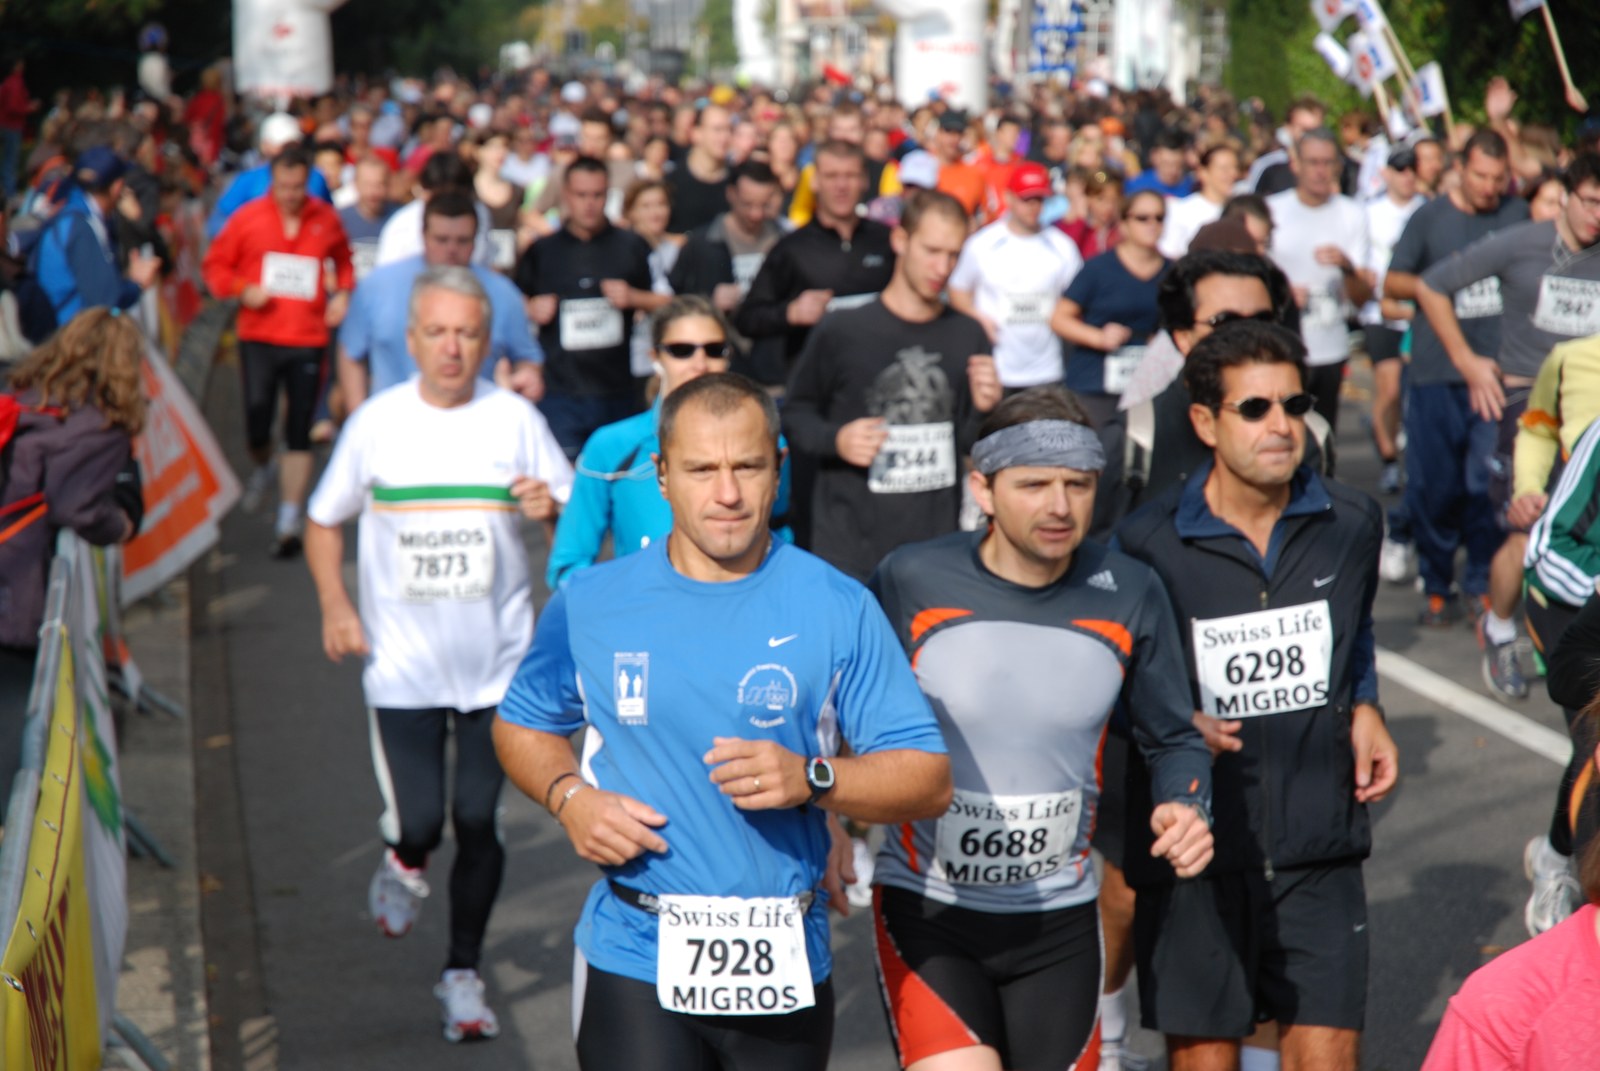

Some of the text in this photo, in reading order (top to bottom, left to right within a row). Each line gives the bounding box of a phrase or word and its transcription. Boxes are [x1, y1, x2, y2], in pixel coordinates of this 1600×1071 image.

[399, 529, 486, 549] MIGROS
[412, 552, 469, 579] 7873
[1203, 609, 1323, 650] Swiss Life
[1225, 644, 1305, 685] 6298
[1215, 681, 1329, 715] MIGROS
[950, 794, 1075, 822] Swiss Life
[960, 827, 1048, 857] 6688
[946, 854, 1060, 884] MIGROS
[667, 903, 740, 927] Swiss
[747, 904, 795, 928] Life
[686, 938, 775, 976] 7928
[673, 985, 799, 1010] MIGROS
